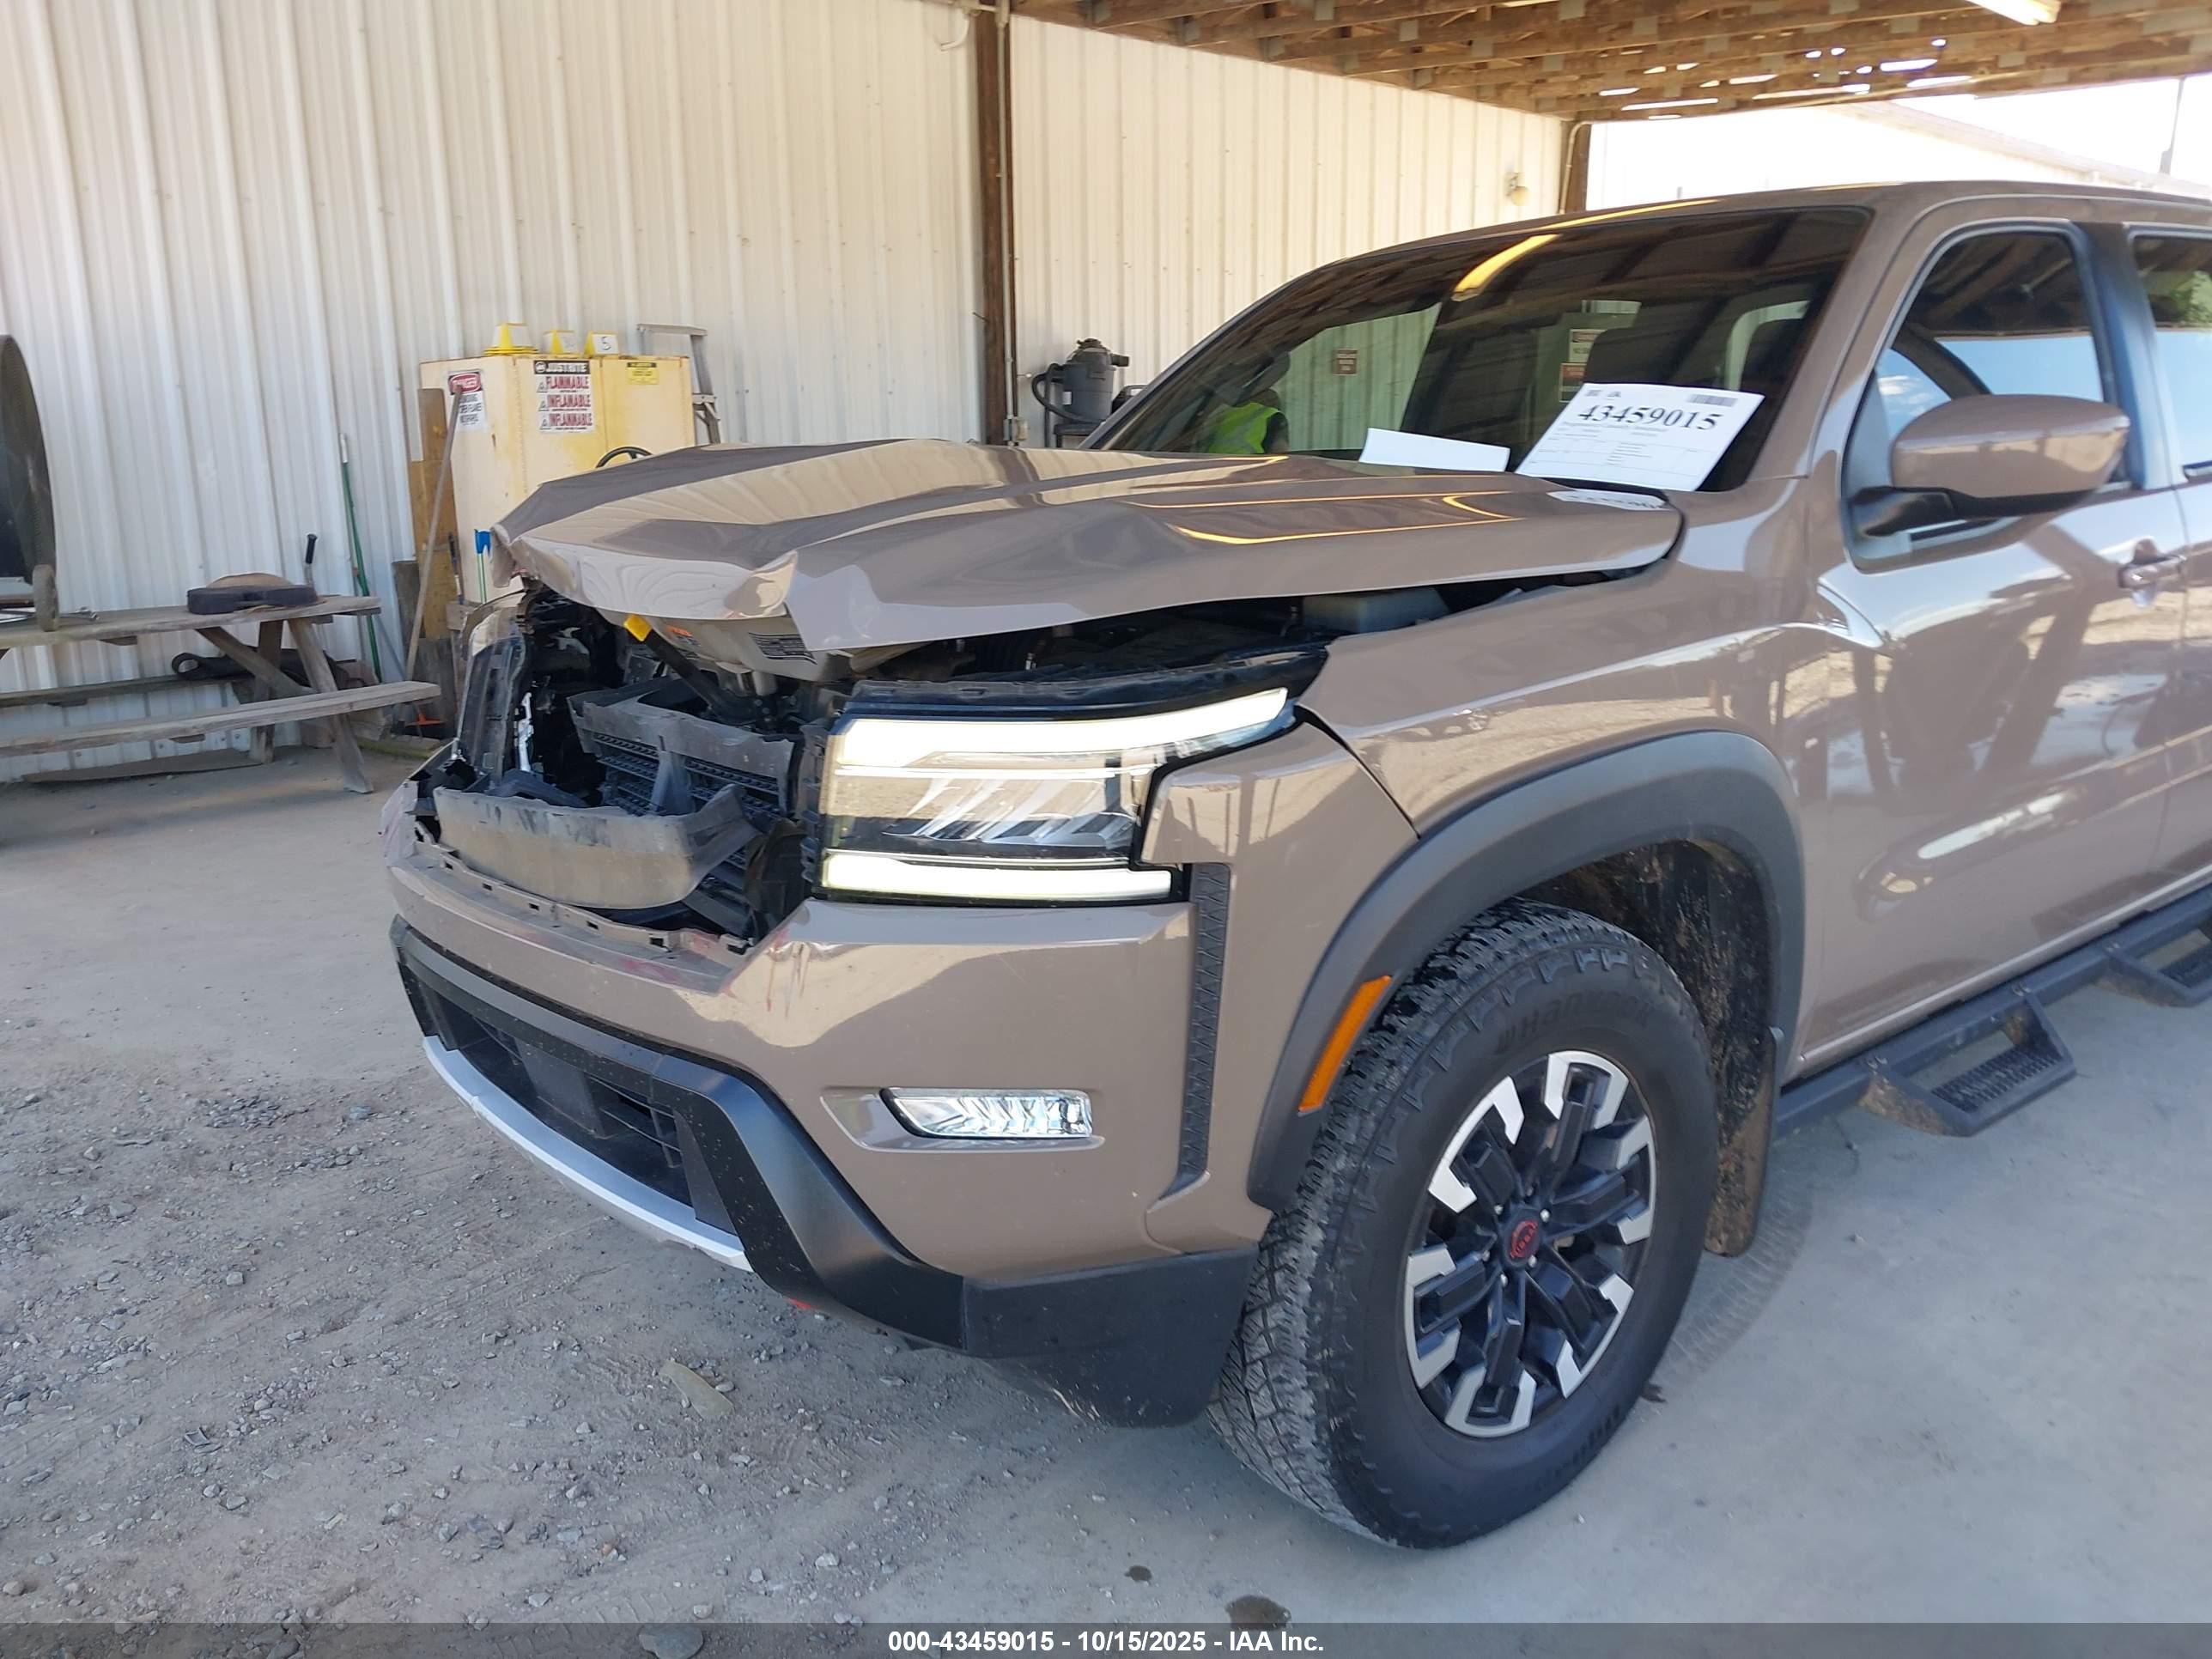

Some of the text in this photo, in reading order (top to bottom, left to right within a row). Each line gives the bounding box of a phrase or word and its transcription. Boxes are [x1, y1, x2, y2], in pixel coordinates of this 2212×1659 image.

[600, 336, 612, 350] 5
[545, 362, 588, 373] JUSTRITE
[546, 376, 589, 389] FLAMMABLE
[1578, 404, 1723, 430] 43459015
